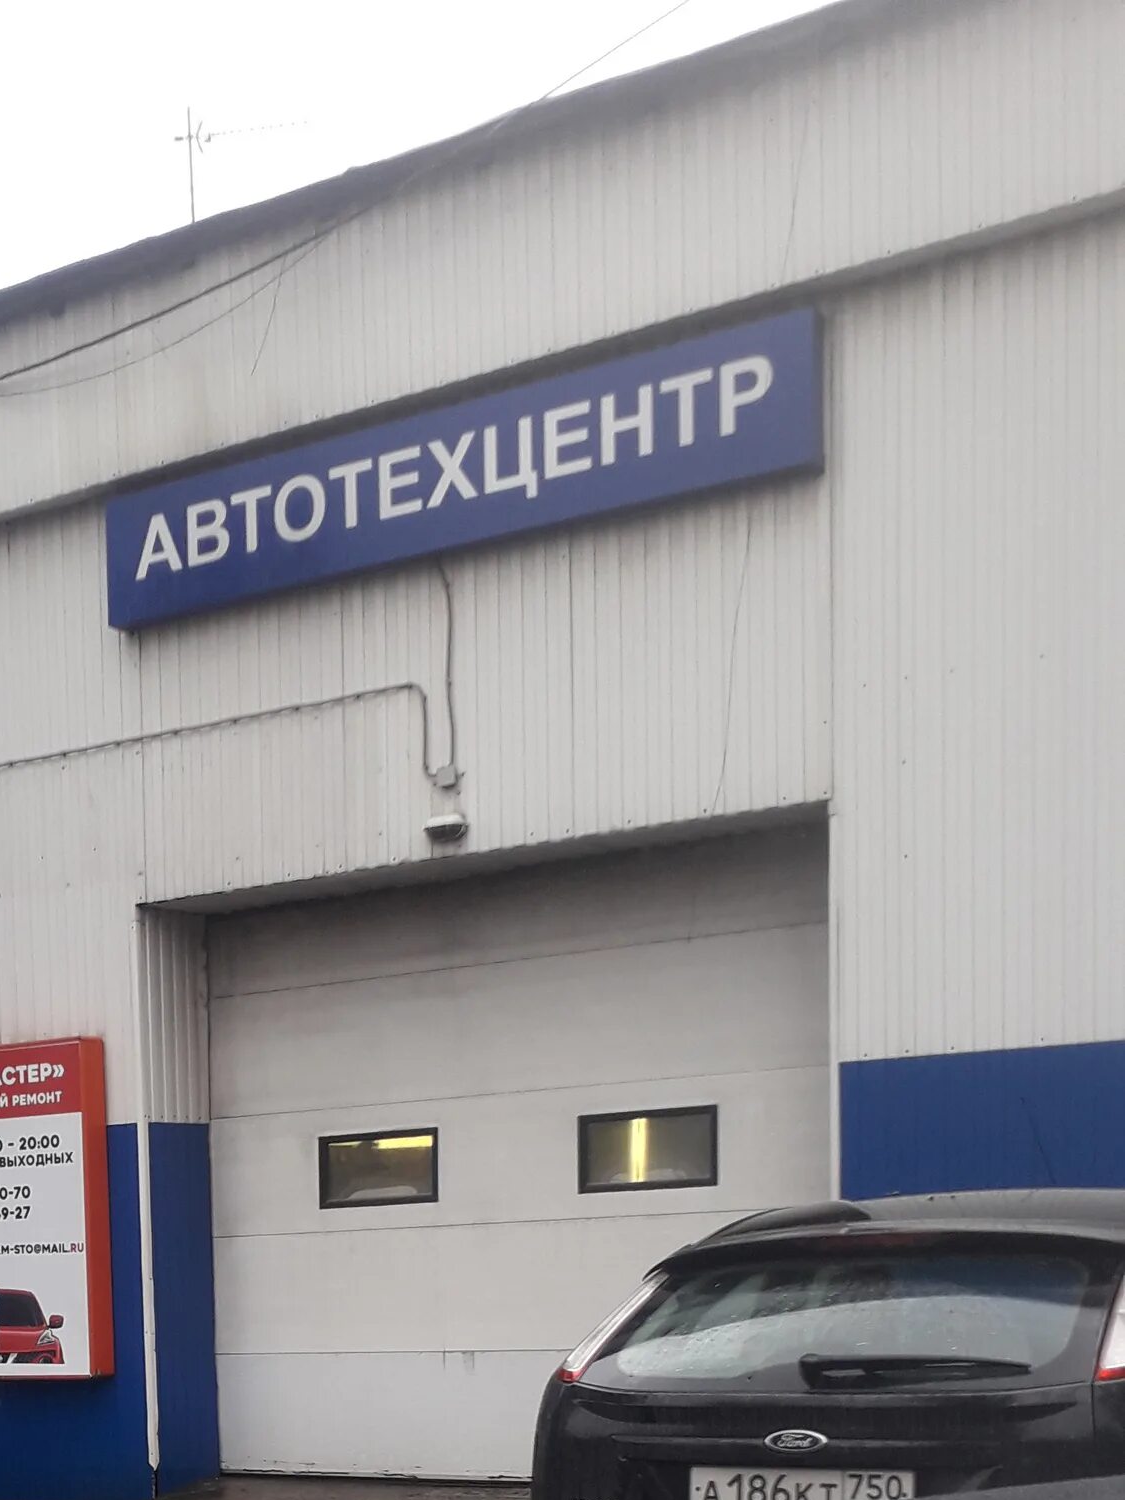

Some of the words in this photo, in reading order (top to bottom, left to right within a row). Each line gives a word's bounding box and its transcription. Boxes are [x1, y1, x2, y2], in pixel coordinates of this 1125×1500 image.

[134, 353, 774, 582] АВТОТЕХЦЕНТР
[11, 1090, 63, 1107] РЕМОНТ
[19, 1134, 61, 1151] 20:00
[0, 1151, 74, 1169] ВЫХОДНЫХ
[776, 1434, 814, 1448] Ford
